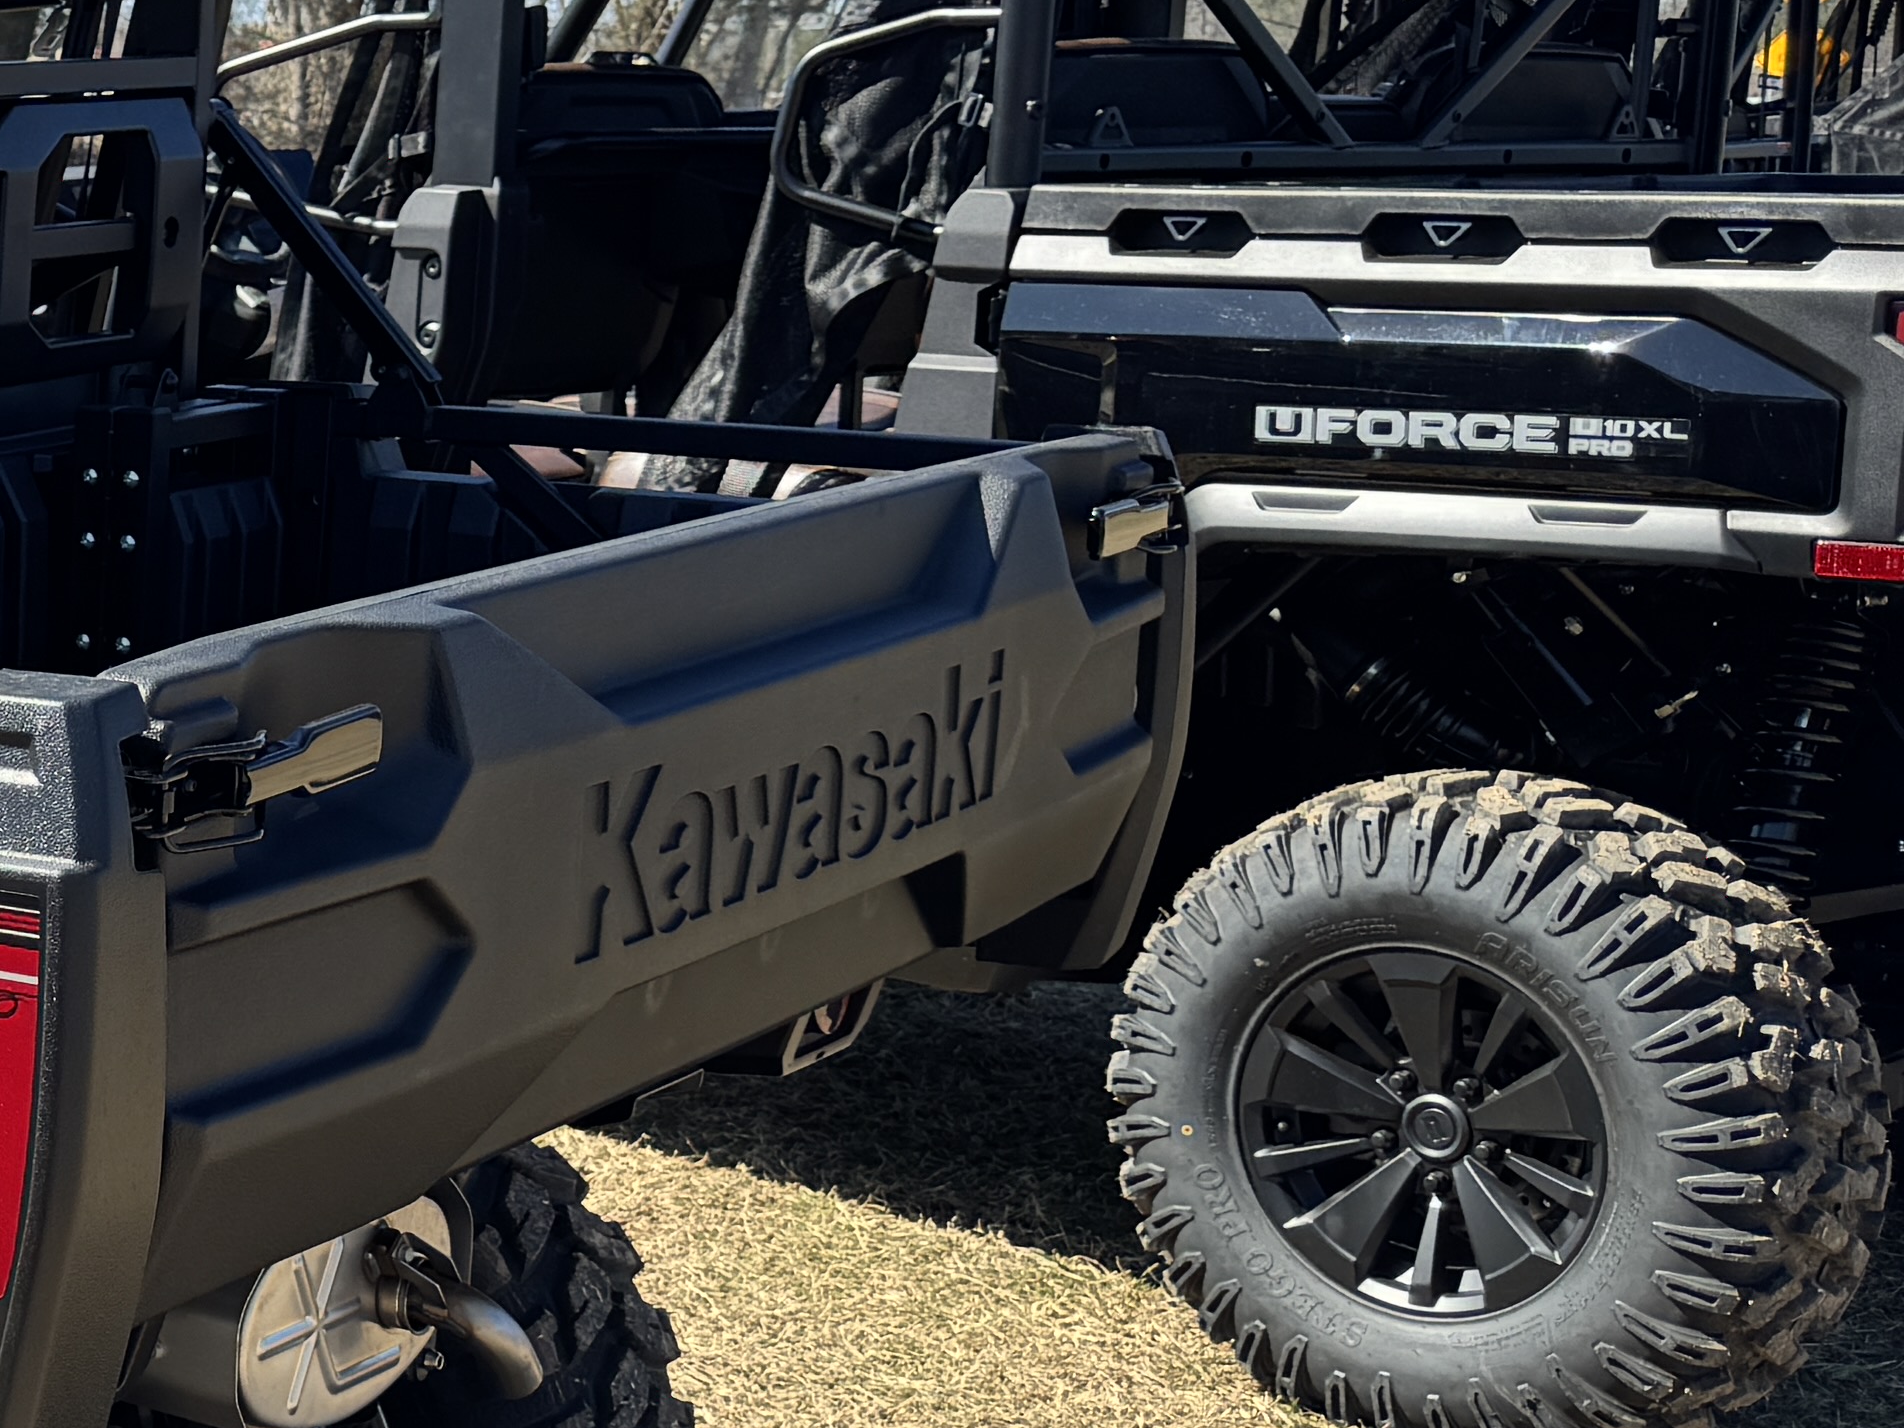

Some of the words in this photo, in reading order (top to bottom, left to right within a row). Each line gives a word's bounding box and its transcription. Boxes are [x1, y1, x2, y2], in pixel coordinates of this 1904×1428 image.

[1568, 439, 1633, 457] PRO
[575, 649, 1005, 966] Kawasaki
[1474, 932, 1616, 1064] ARISUN
